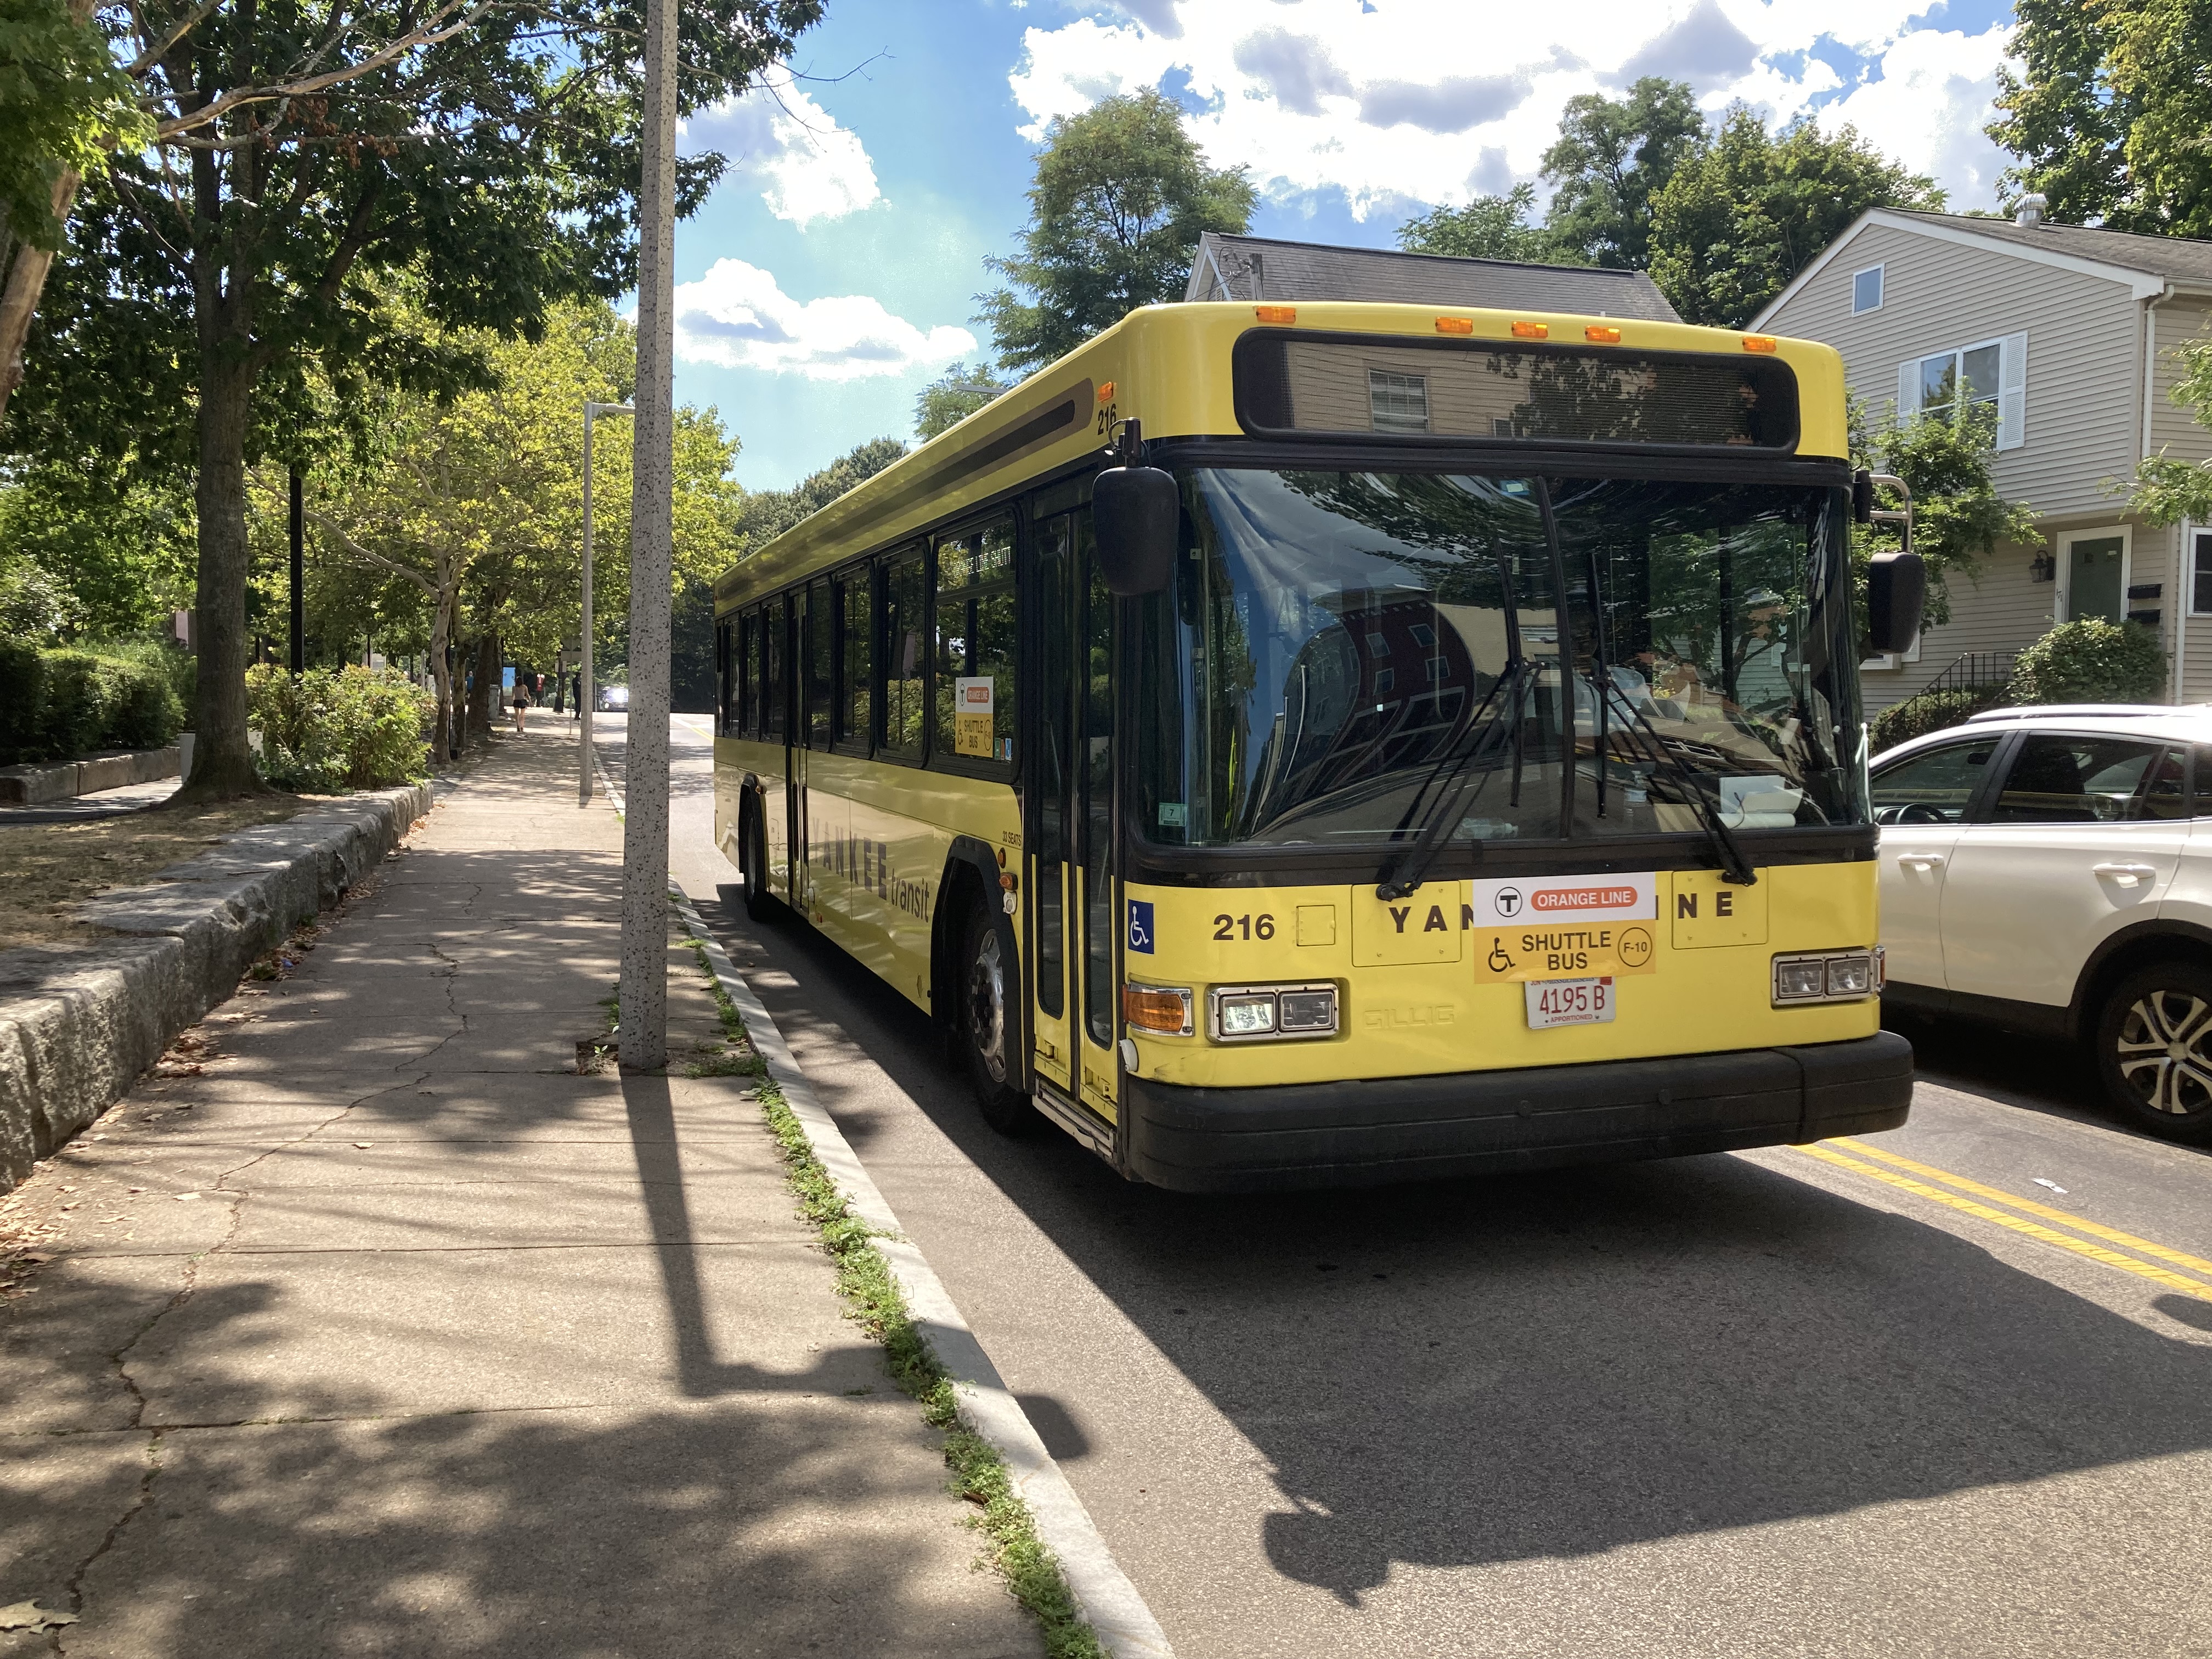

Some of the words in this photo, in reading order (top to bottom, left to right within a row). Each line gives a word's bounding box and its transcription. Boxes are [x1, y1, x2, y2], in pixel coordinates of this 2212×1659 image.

[1098, 403, 1116, 436] 216
[964, 719, 983, 733] SHUTTLE
[969, 735, 978, 748] BUS
[1008, 831, 1022, 847] SEATS
[812, 816, 887, 901] YANKEE
[891, 867, 930, 923] transit
[1537, 892, 1597, 907] ORANGE
[1601, 890, 1632, 904] LINE
[1213, 913, 1275, 940] 216
[1388, 904, 1474, 933] YAN
[1522, 930, 1611, 952] SHUTTLE
[1623, 941, 1647, 953] F-10
[1548, 952, 1588, 970] BUS
[1539, 986, 1587, 1014] 4195
[1594, 985, 1605, 1011] B
[1363, 1005, 1454, 1029] GILLIG
[1550, 1014, 1593, 1023] APPORTIONED
